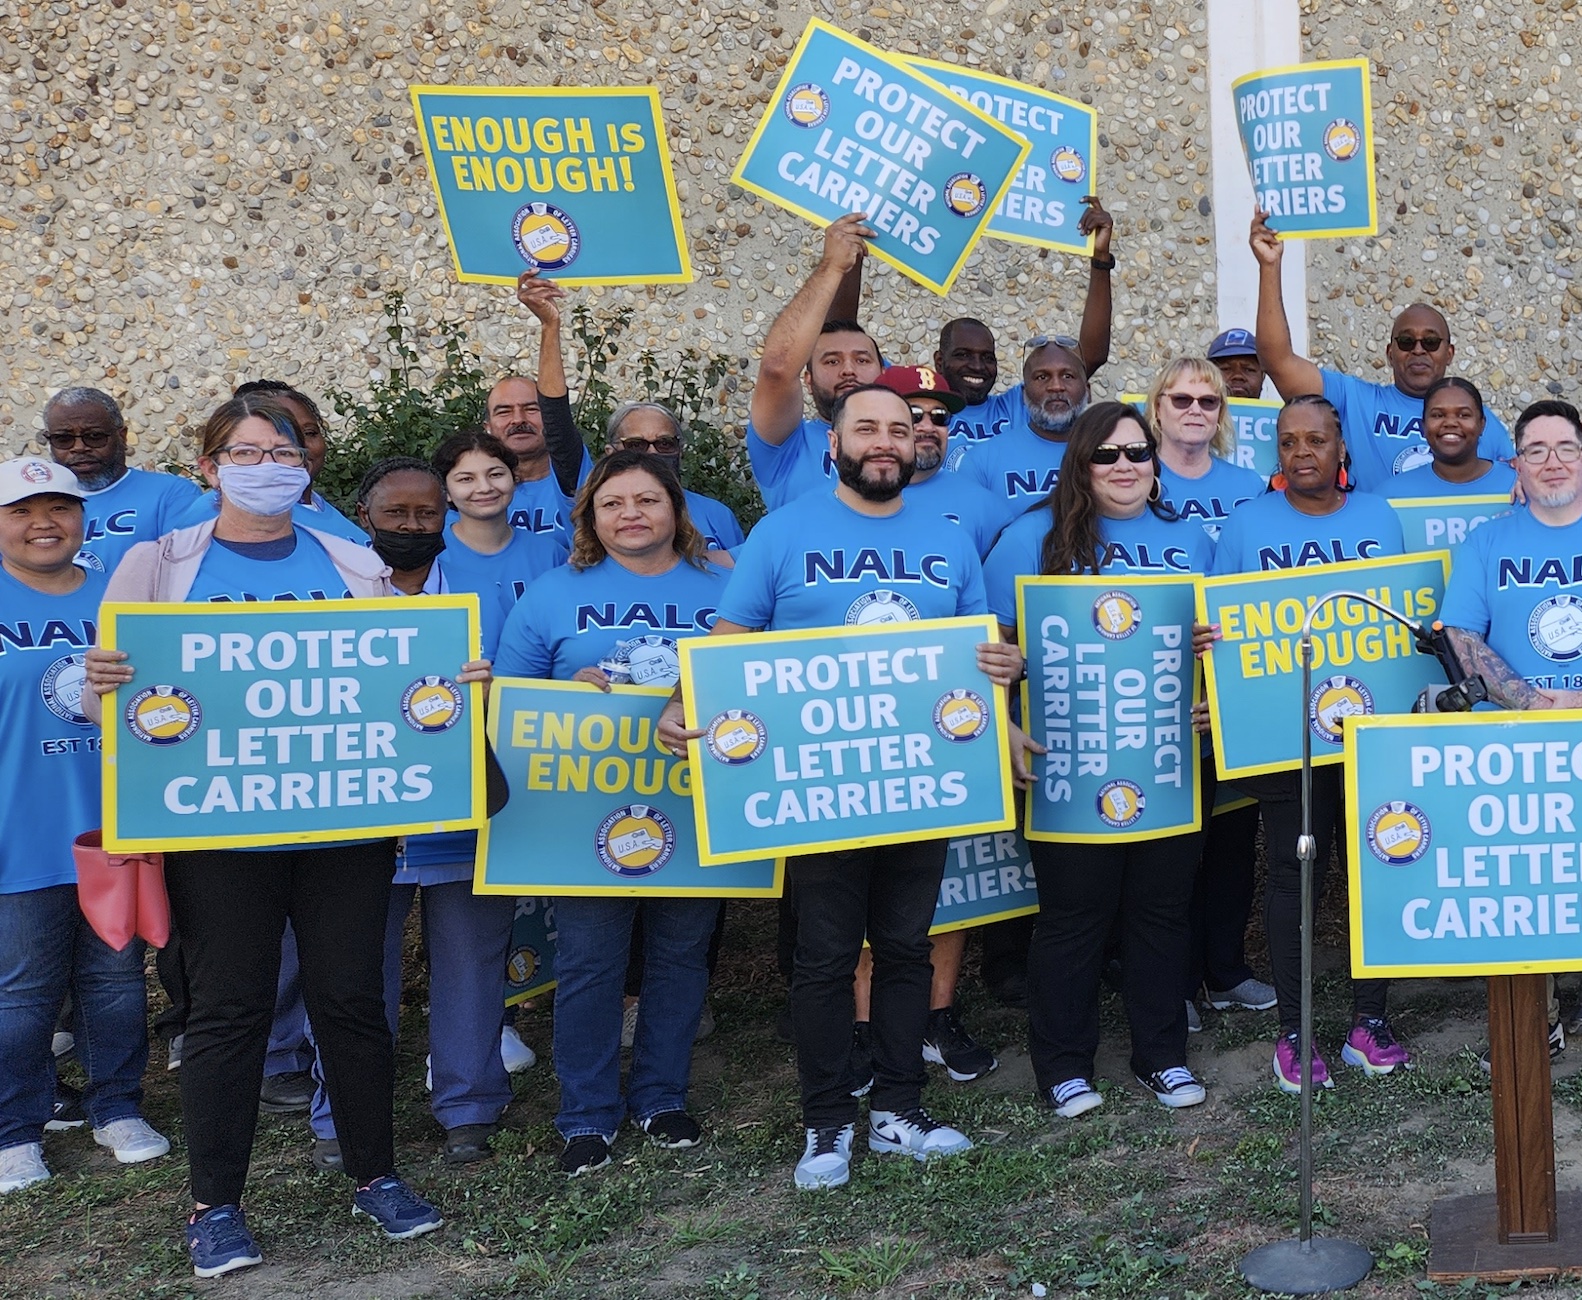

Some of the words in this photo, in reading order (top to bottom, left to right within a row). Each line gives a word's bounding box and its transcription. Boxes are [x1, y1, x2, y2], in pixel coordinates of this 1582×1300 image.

[832, 57, 986, 159] PROTECT
[1240, 83, 1331, 124] PROTECT
[432, 116, 595, 153] ENOUGH
[607, 123, 645, 153] IS
[854, 110, 932, 171] OUR
[1253, 120, 1302, 152] OUR
[451, 156, 635, 193] ENOUGH!
[814, 128, 936, 215] LETTER
[777, 151, 941, 255] CARRIERS
[916, 367, 936, 390] B
[949, 418, 1011, 441] ALC
[1374, 411, 1427, 441] NA
[803, 547, 949, 590] NALC
[1219, 587, 1392, 642] ENOUGH
[1403, 587, 1436, 618] IS
[181, 627, 419, 672] PROTECT
[743, 645, 944, 697] PROTECT
[244, 677, 362, 719] OUR
[800, 693, 899, 735] OUR
[1040, 614, 1072, 804] CARRIERS
[1075, 643, 1108, 777] LETTER
[1113, 668, 1147, 750] OUR
[1152, 624, 1182, 788] PROTECT
[41, 737, 80, 756] EST
[207, 722, 398, 767] LETTER
[772, 733, 934, 782] LETTER
[163, 764, 433, 815] CARRIERS
[528, 754, 692, 797] ENOUG
[744, 771, 968, 828] CARRIERS
[1468, 792, 1576, 836] OUR
[949, 832, 1019, 869] TER
